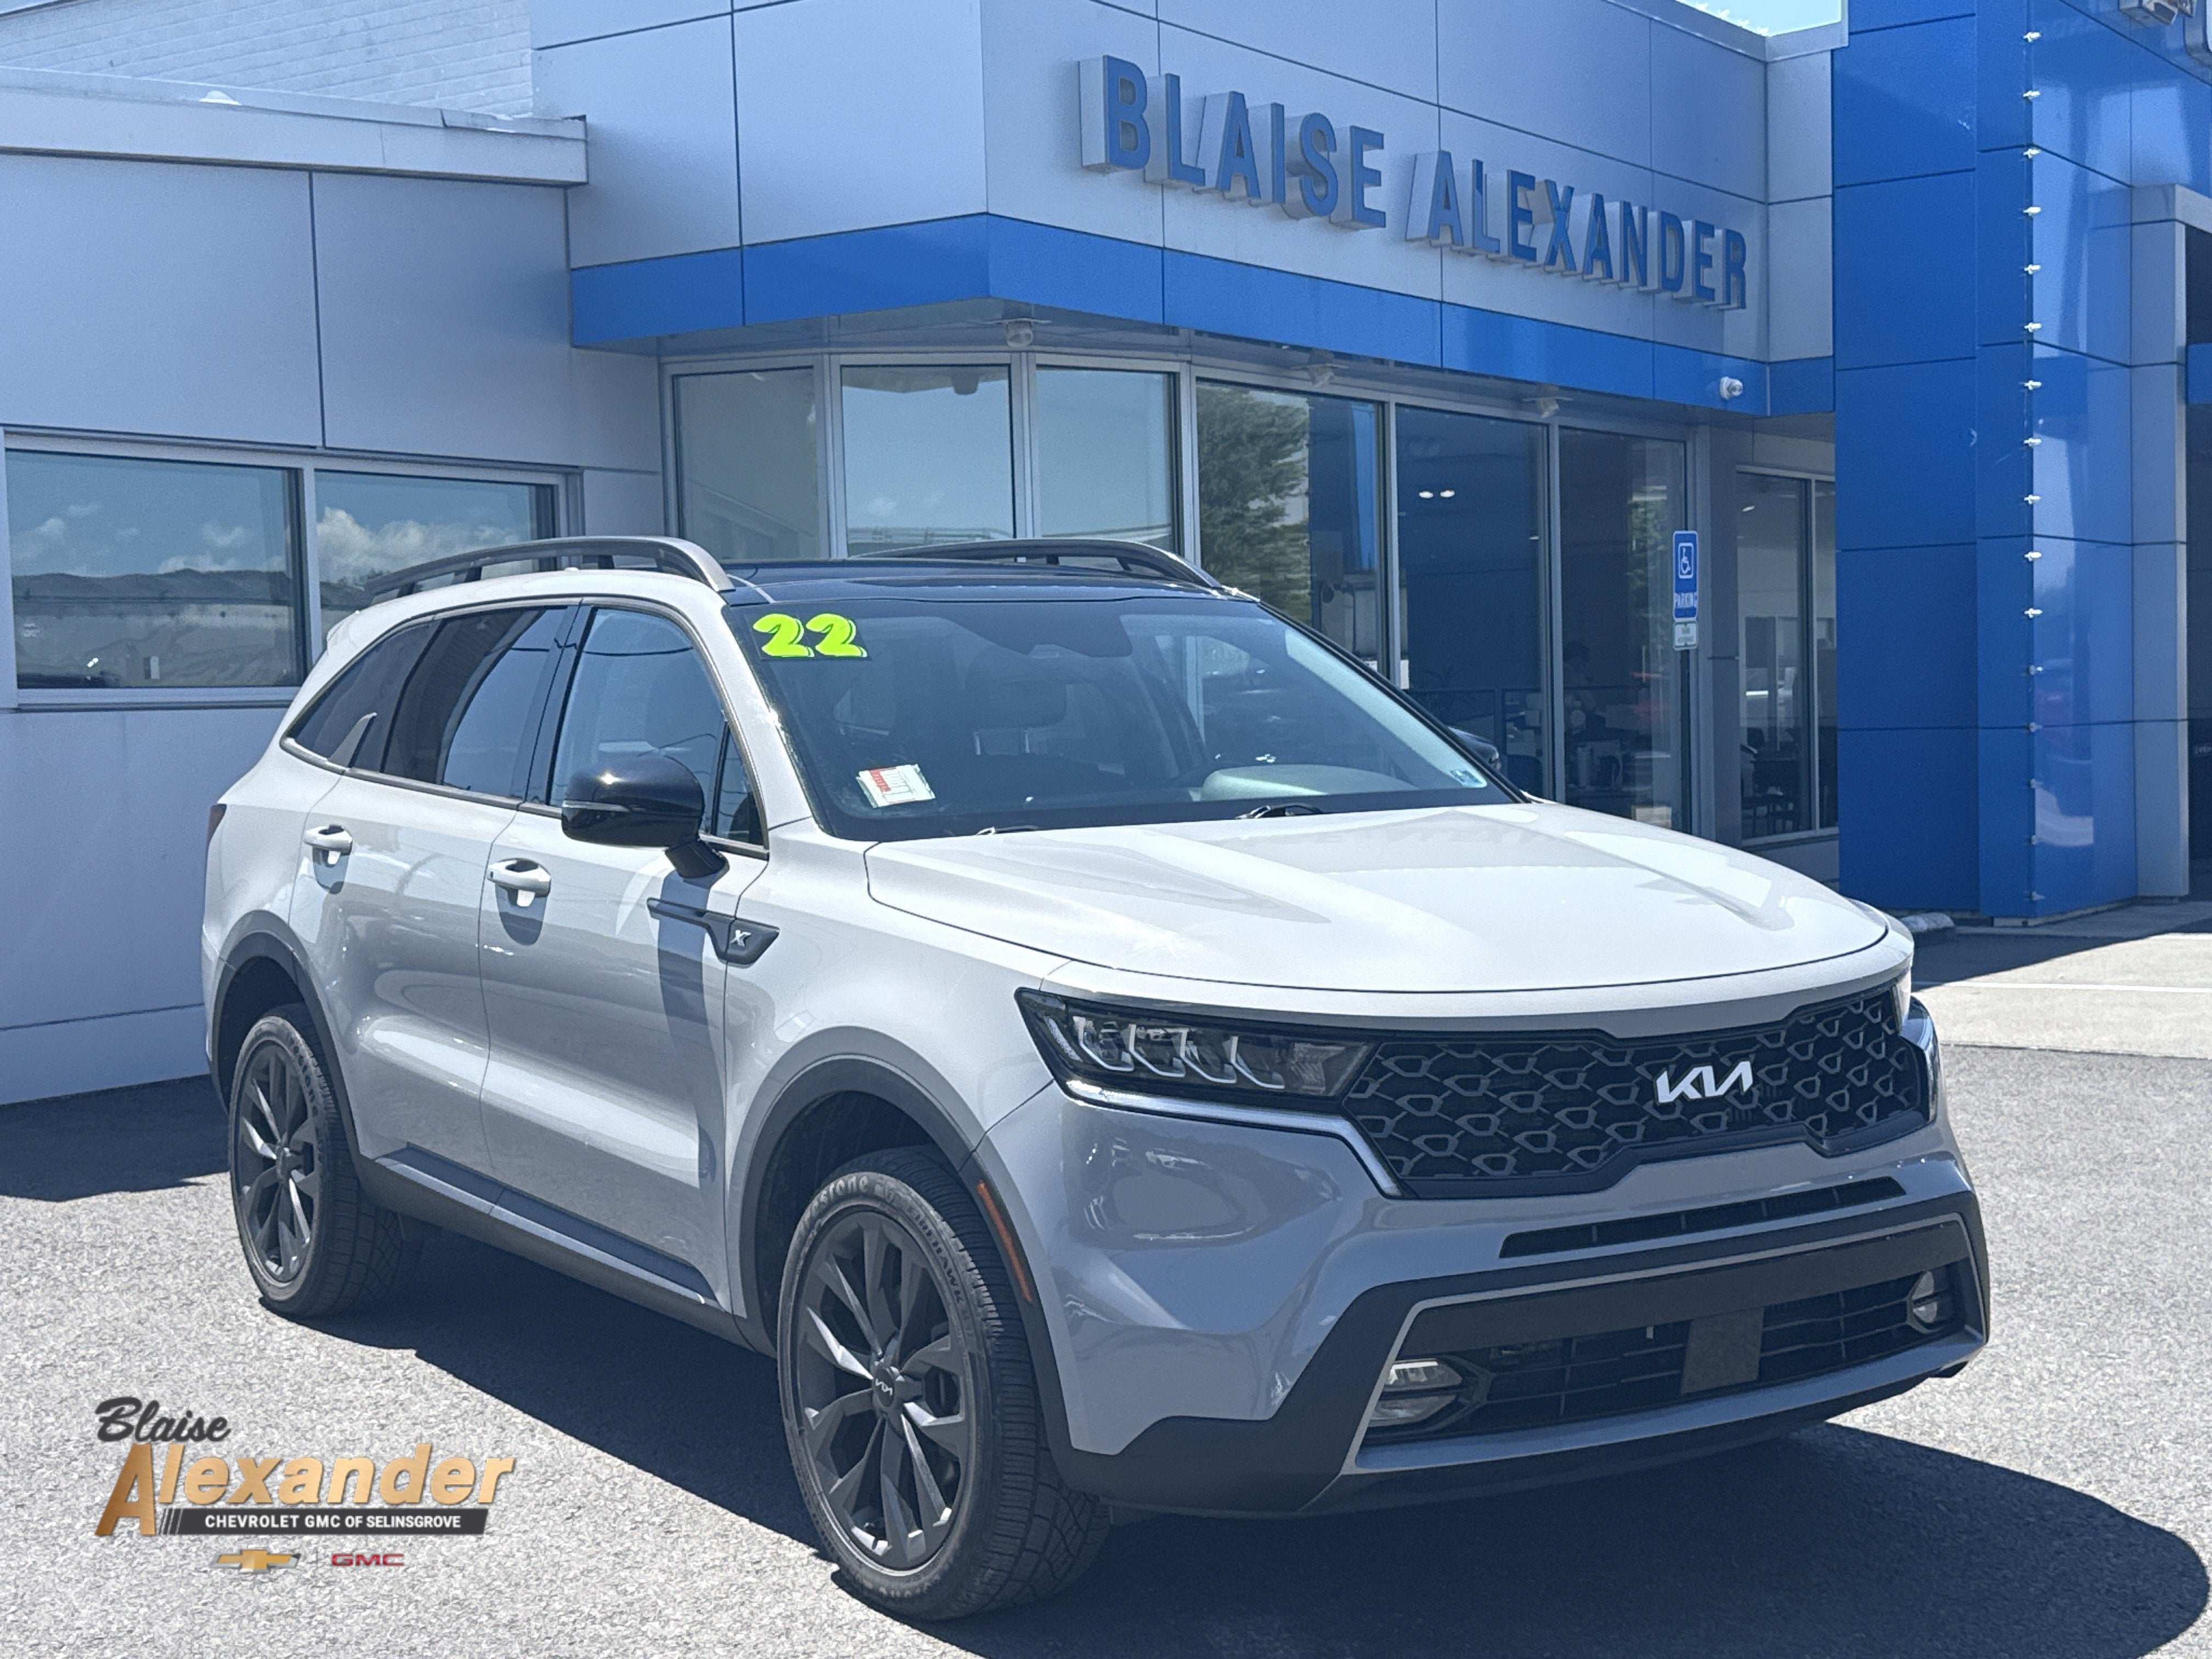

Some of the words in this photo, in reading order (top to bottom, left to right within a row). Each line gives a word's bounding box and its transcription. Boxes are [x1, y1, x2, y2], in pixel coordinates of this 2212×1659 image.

[1102, 54, 1387, 229] BLAISE
[1427, 150, 1747, 309] ALEXANDER
[753, 613, 868, 658] 22
[1656, 1060, 1753, 1103] KIA
